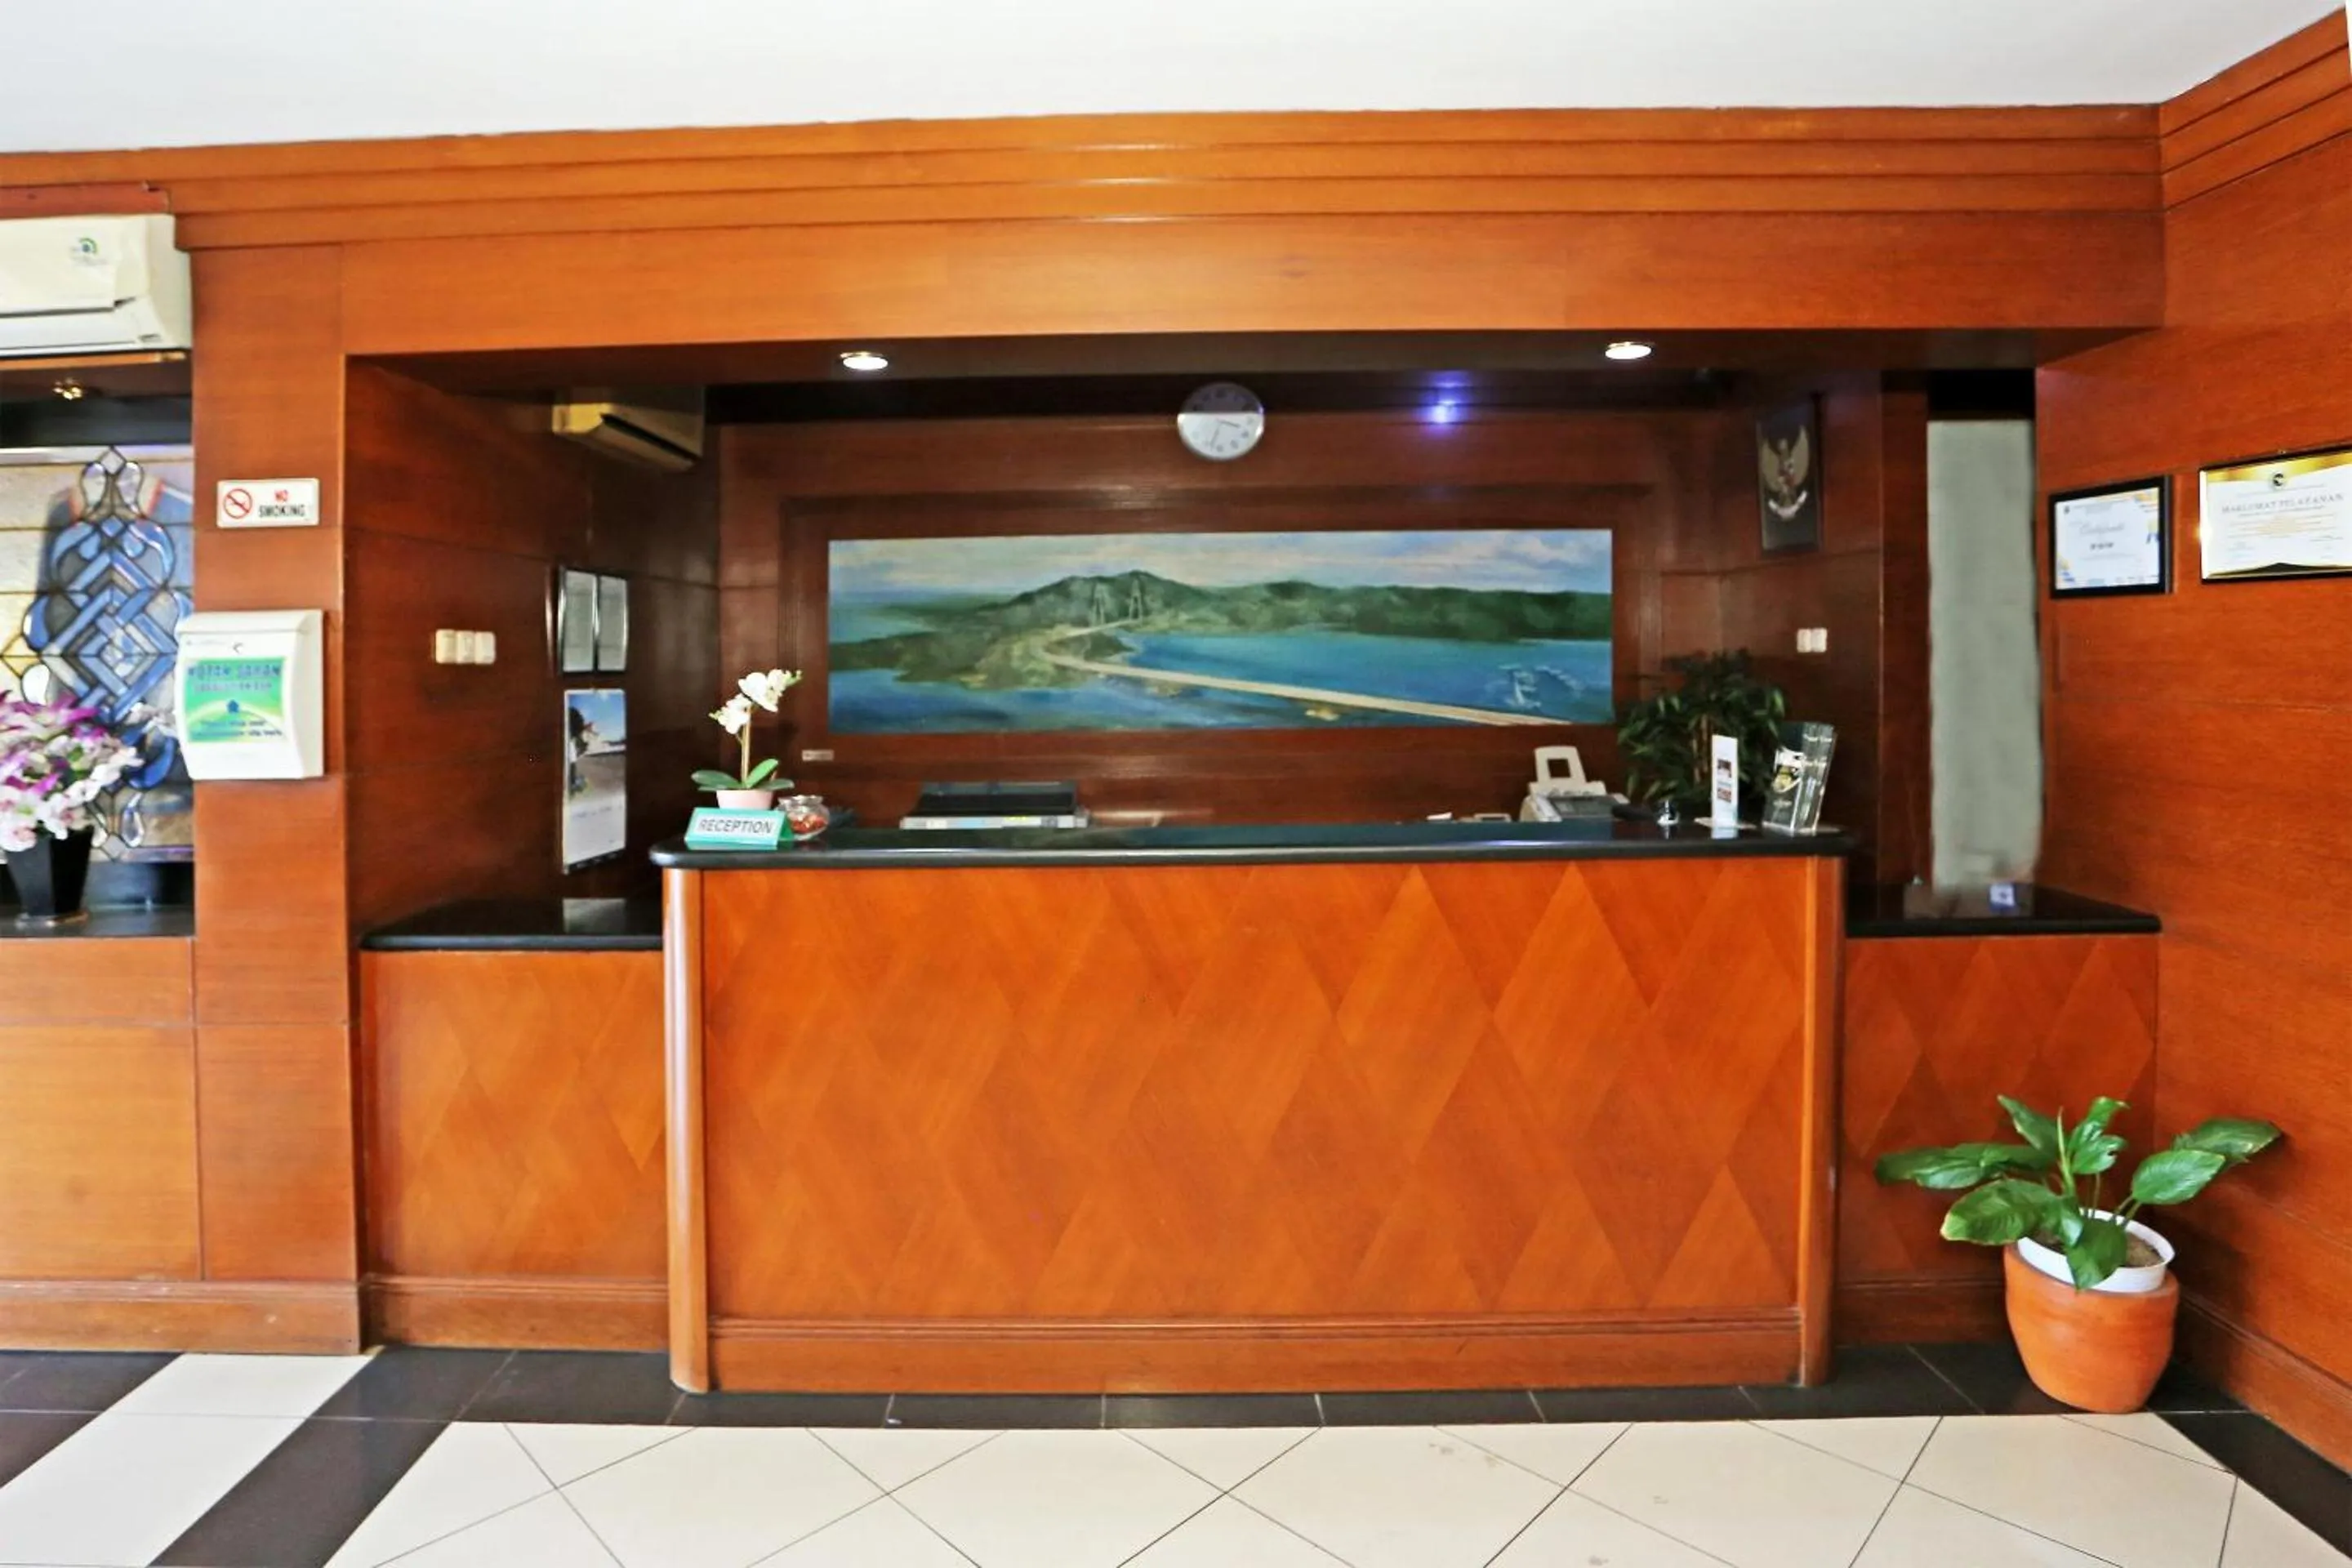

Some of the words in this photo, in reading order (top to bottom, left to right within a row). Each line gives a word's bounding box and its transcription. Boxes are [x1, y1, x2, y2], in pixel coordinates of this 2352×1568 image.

[274, 489, 288, 501] NO
[259, 504, 305, 517] SMOKING
[698, 819, 773, 834] RECEPTION
